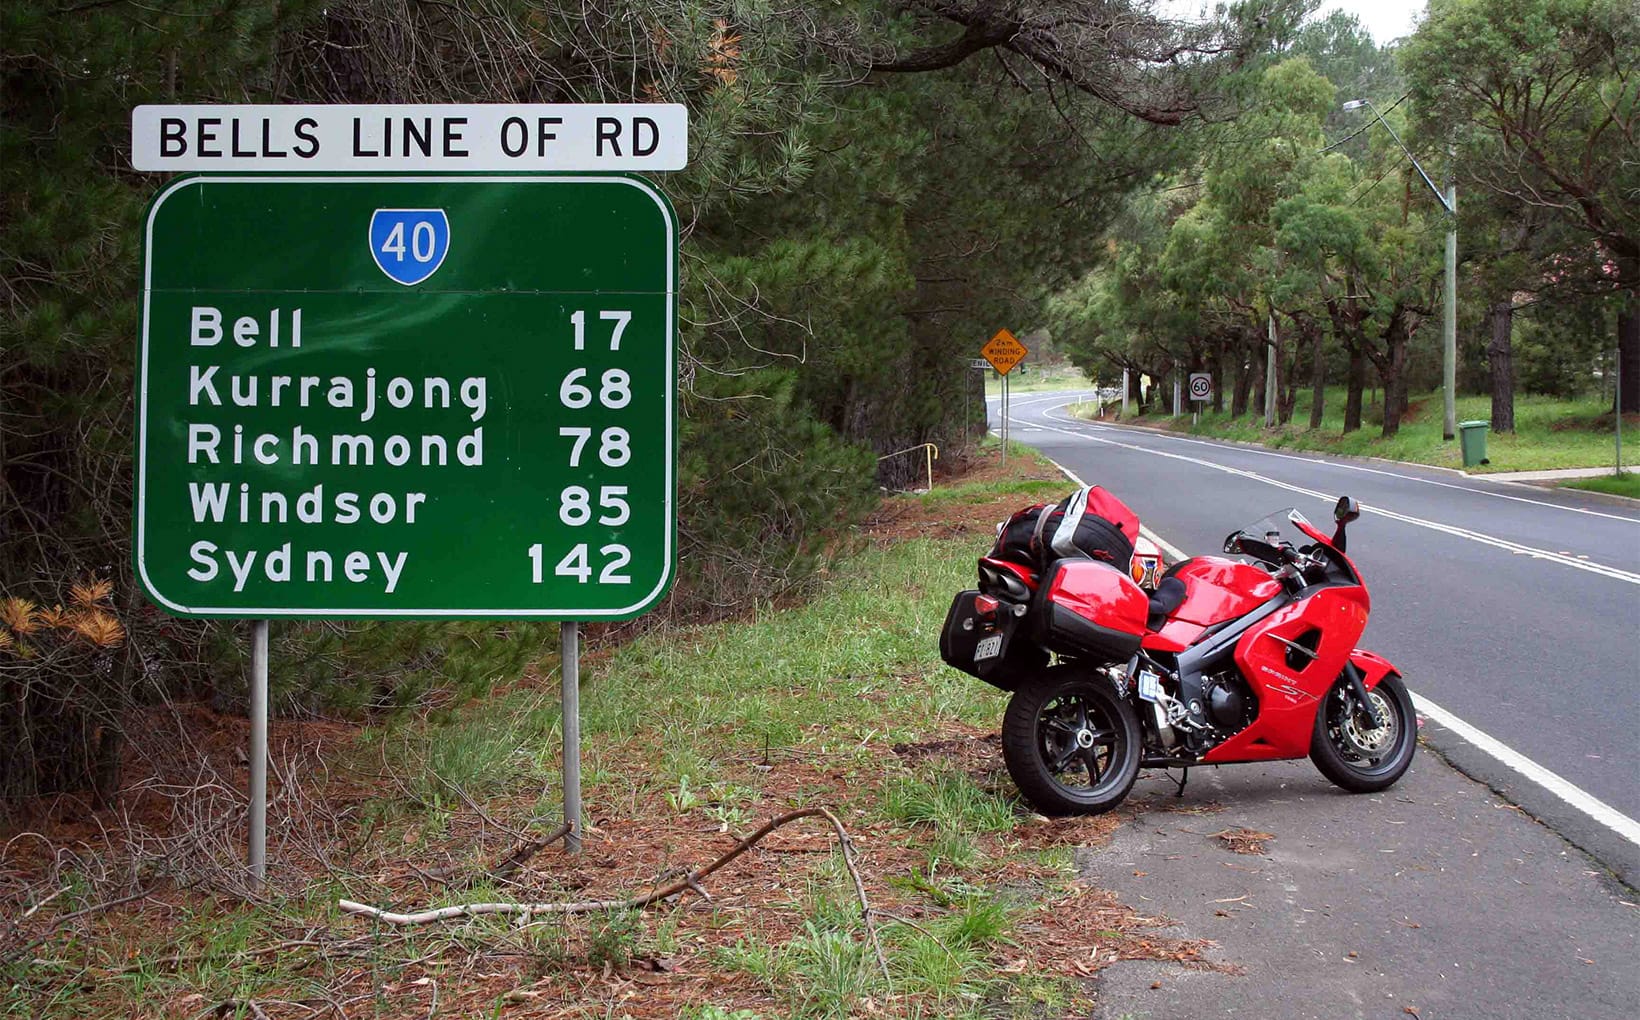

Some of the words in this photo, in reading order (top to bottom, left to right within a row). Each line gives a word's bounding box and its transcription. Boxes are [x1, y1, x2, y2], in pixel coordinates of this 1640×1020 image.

[159, 117, 320, 159] BELLS
[352, 117, 469, 157] LINE
[500, 116, 563, 158] OF
[596, 117, 660, 157] RD
[381, 221, 436, 263] 40
[190, 306, 302, 348] Bell
[570, 310, 632, 351] 17
[988, 347, 1021, 356] WINDING
[993, 356, 1016, 365] ROAD
[189, 365, 487, 422] Kurrajong
[559, 367, 632, 409] 68
[1193, 381, 1208, 392] 60
[188, 423, 483, 467] Richmond
[559, 426, 632, 468] 78
[189, 482, 426, 524] Windsor
[559, 485, 632, 527] 85
[187, 540, 409, 593] Sydney
[528, 543, 632, 584] 142
